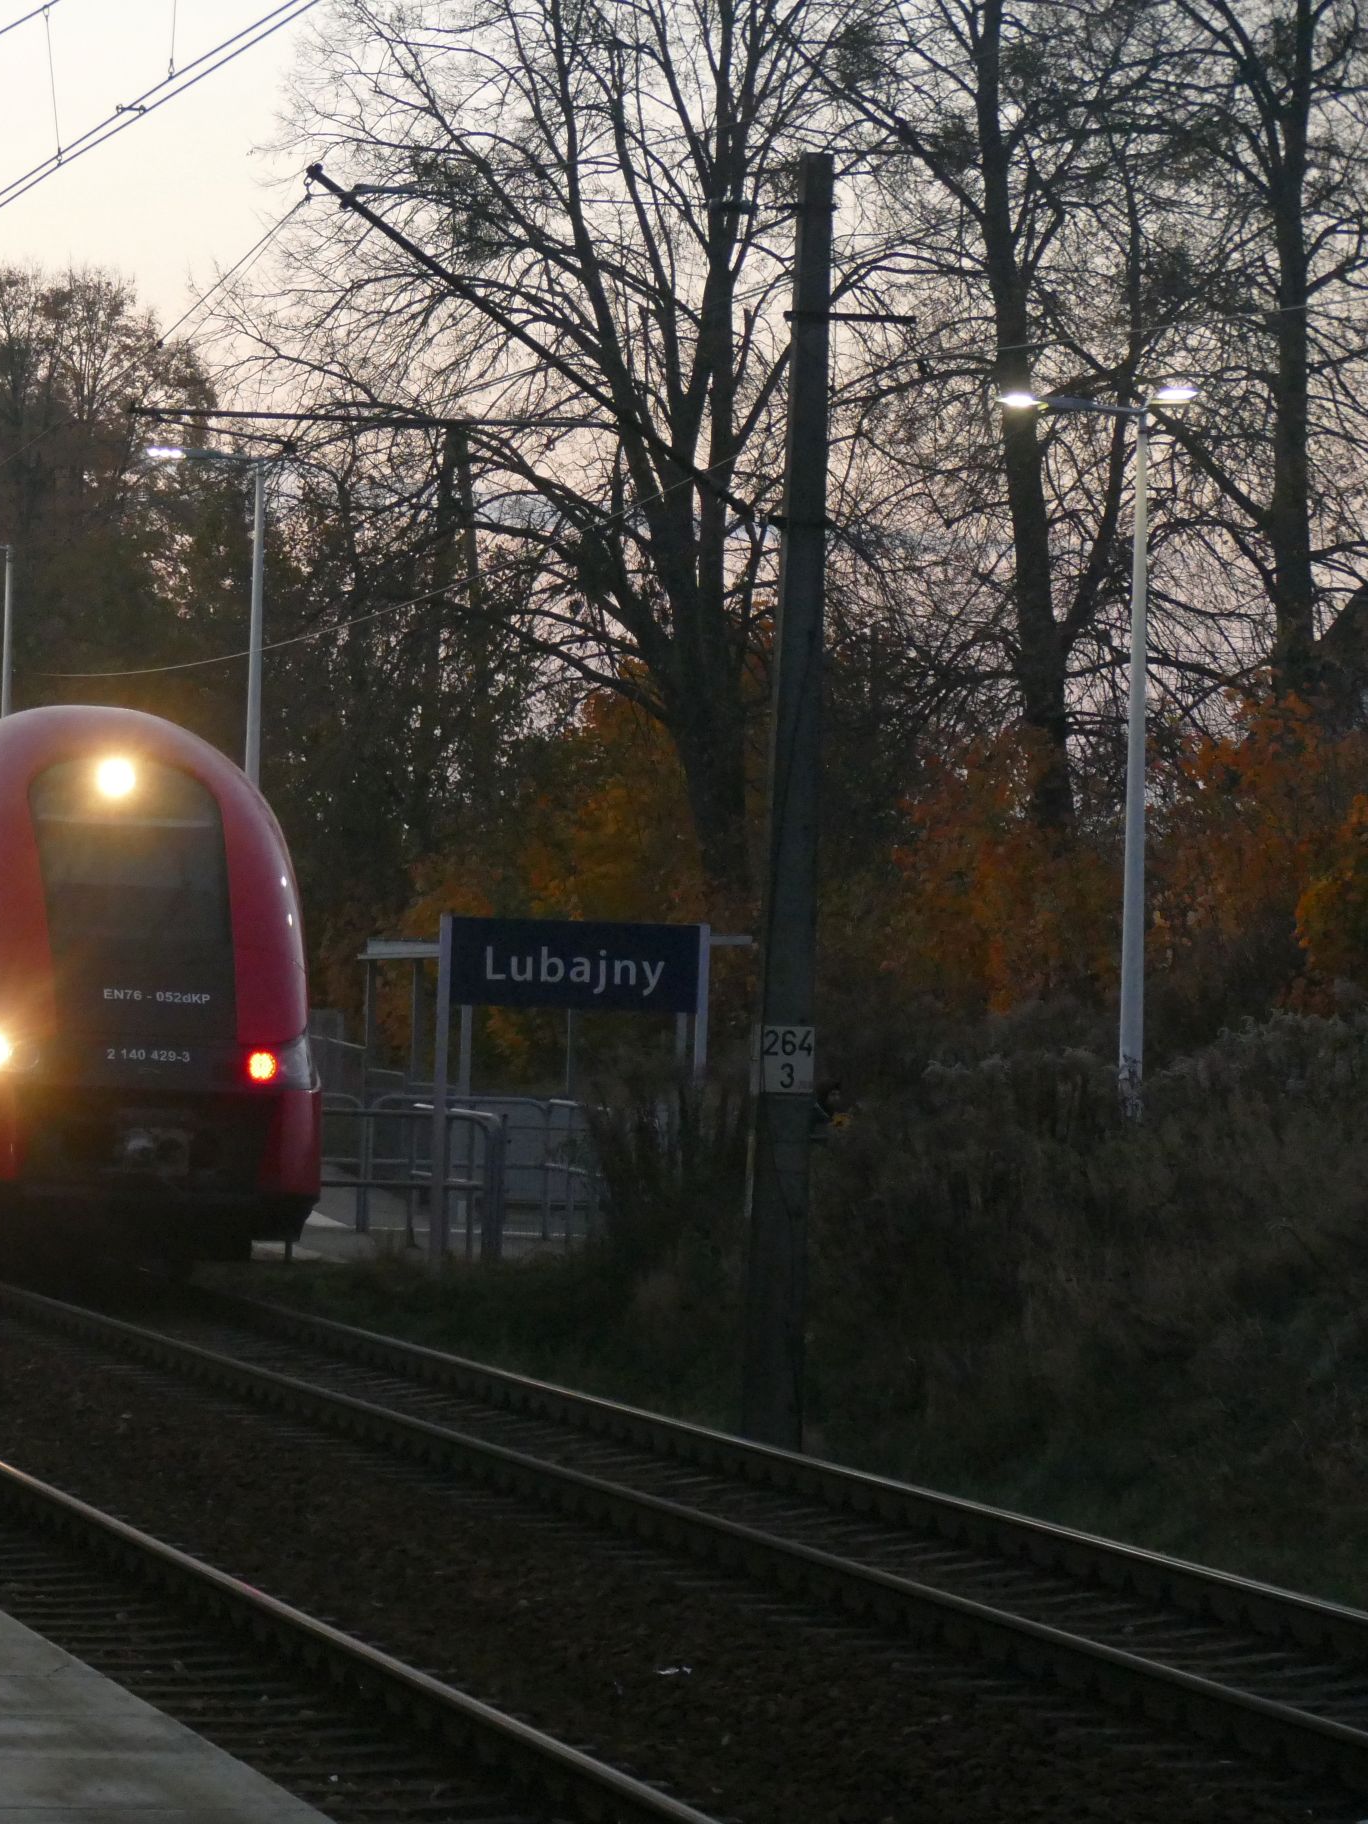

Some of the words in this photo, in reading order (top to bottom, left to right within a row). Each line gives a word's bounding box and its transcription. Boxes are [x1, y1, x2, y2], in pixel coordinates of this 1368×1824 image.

[486, 946, 665, 996] Lubajny
[103, 988, 143, 1001] EN76
[106, 1048, 116, 1060] 2
[120, 1048, 146, 1060] 140
[150, 1050, 191, 1063] 429-3
[763, 1029, 813, 1057] 264
[780, 1062, 795, 1089] 3
